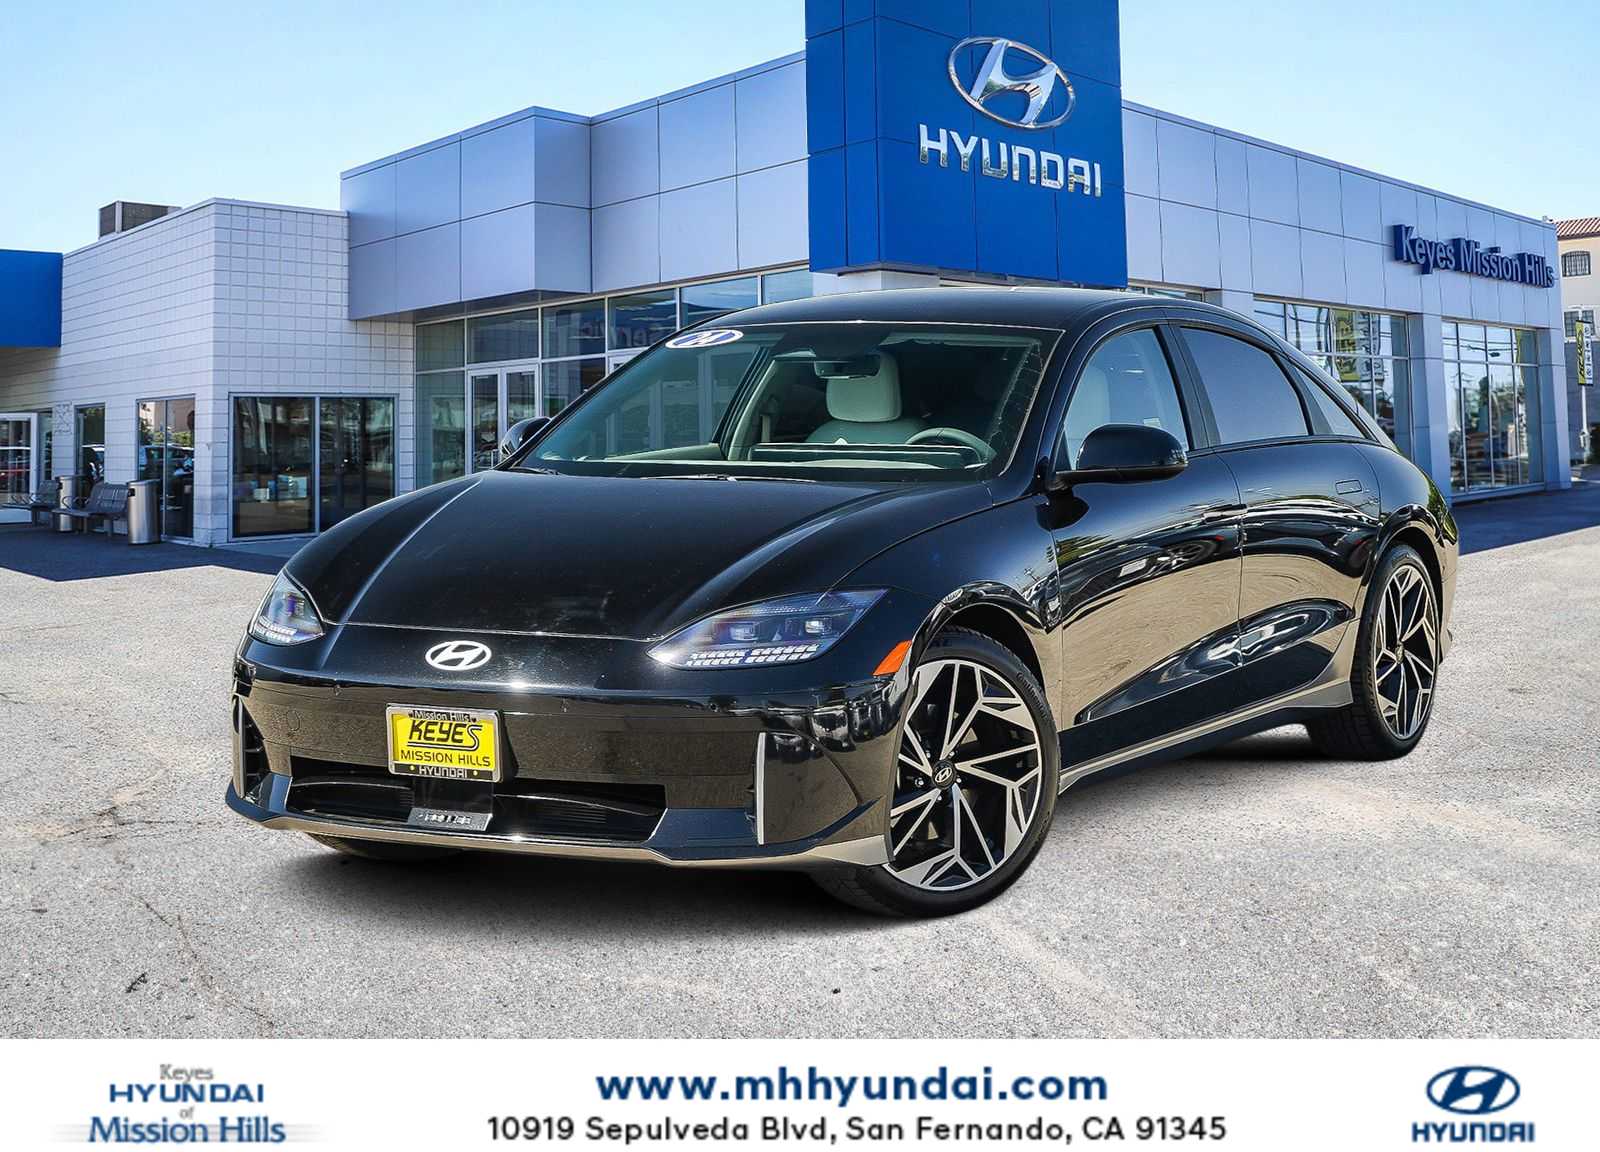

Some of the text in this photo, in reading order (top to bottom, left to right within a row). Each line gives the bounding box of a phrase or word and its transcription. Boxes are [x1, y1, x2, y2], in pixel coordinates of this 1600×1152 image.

[919, 123, 1102, 197] HYUNDAI
[1393, 224, 1555, 288] Keyes Mission Hills
[413, 710, 471, 722] Mission Hills
[407, 720, 483, 750] KEYES
[400, 749, 492, 767] MISSION HILLS
[419, 766, 468, 778] HYUNDAI
